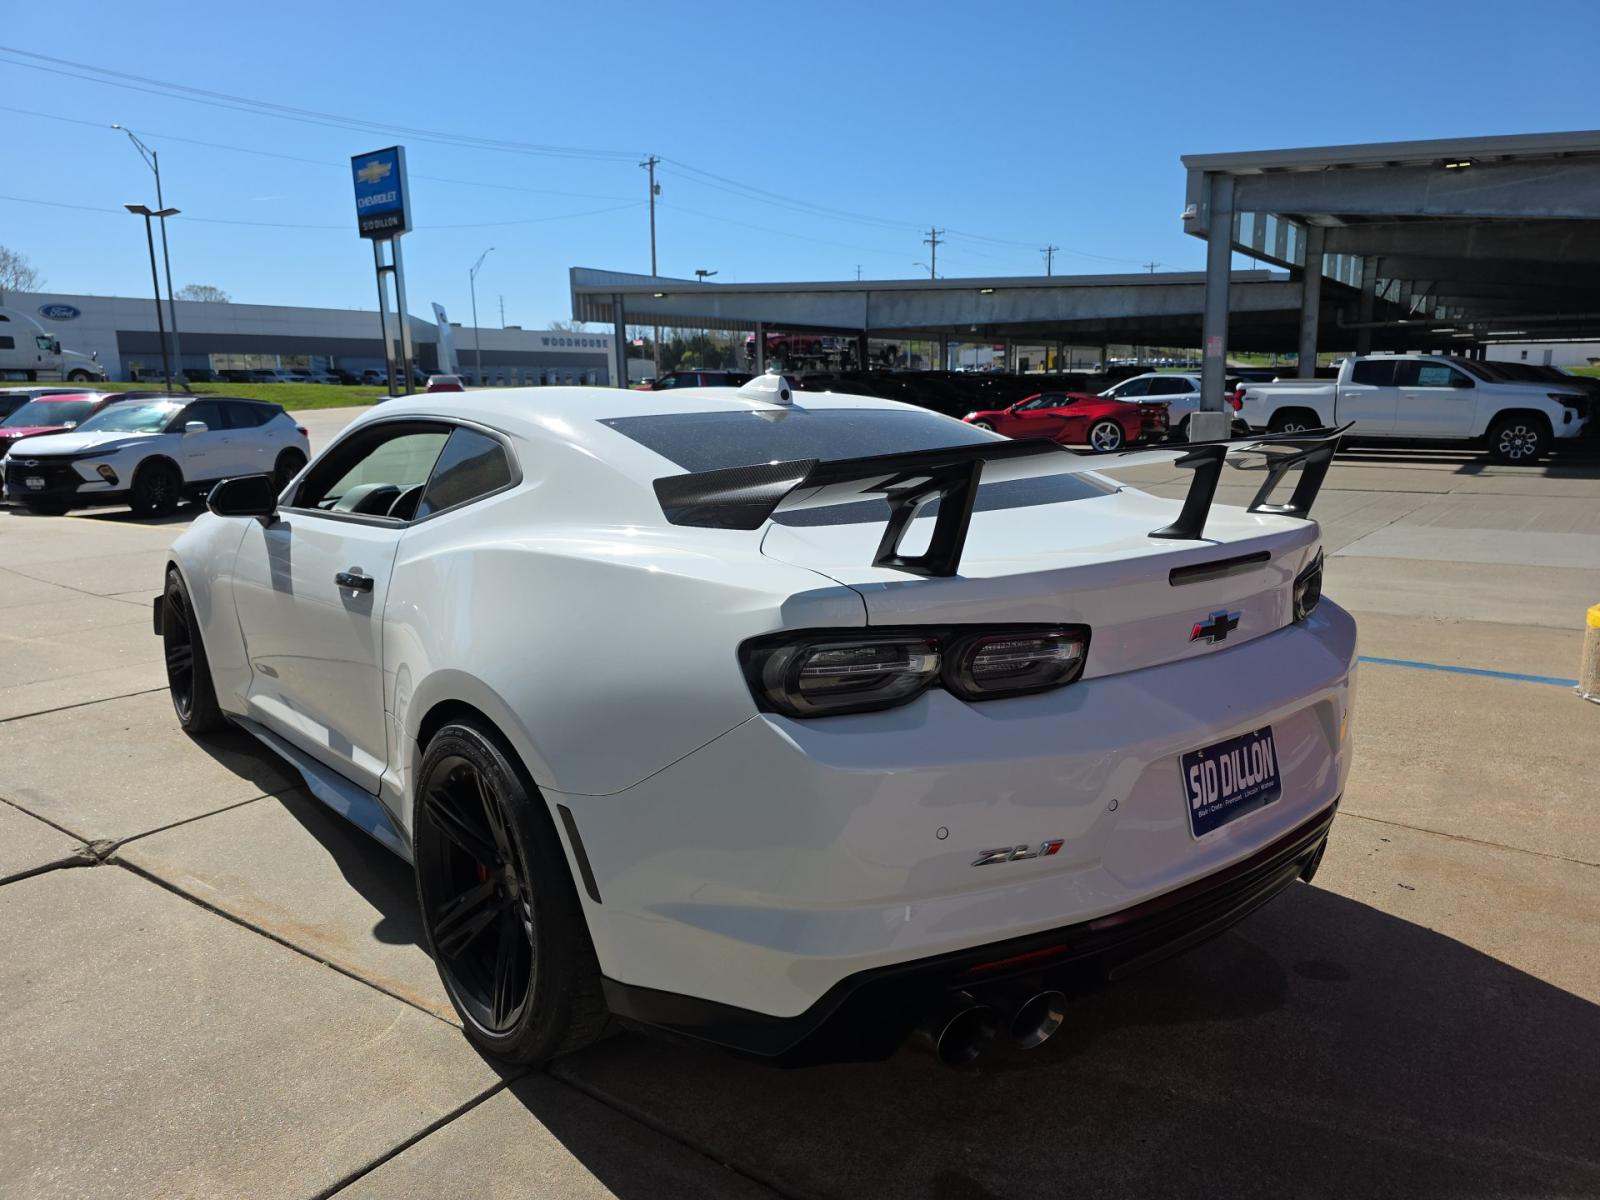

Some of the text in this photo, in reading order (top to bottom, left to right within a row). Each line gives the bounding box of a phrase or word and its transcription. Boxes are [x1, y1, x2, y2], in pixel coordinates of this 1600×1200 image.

[541, 336, 609, 348] WOODHOUSE
[1189, 737, 1275, 810] SID DILLON
[970, 839, 1065, 867] ZL1
